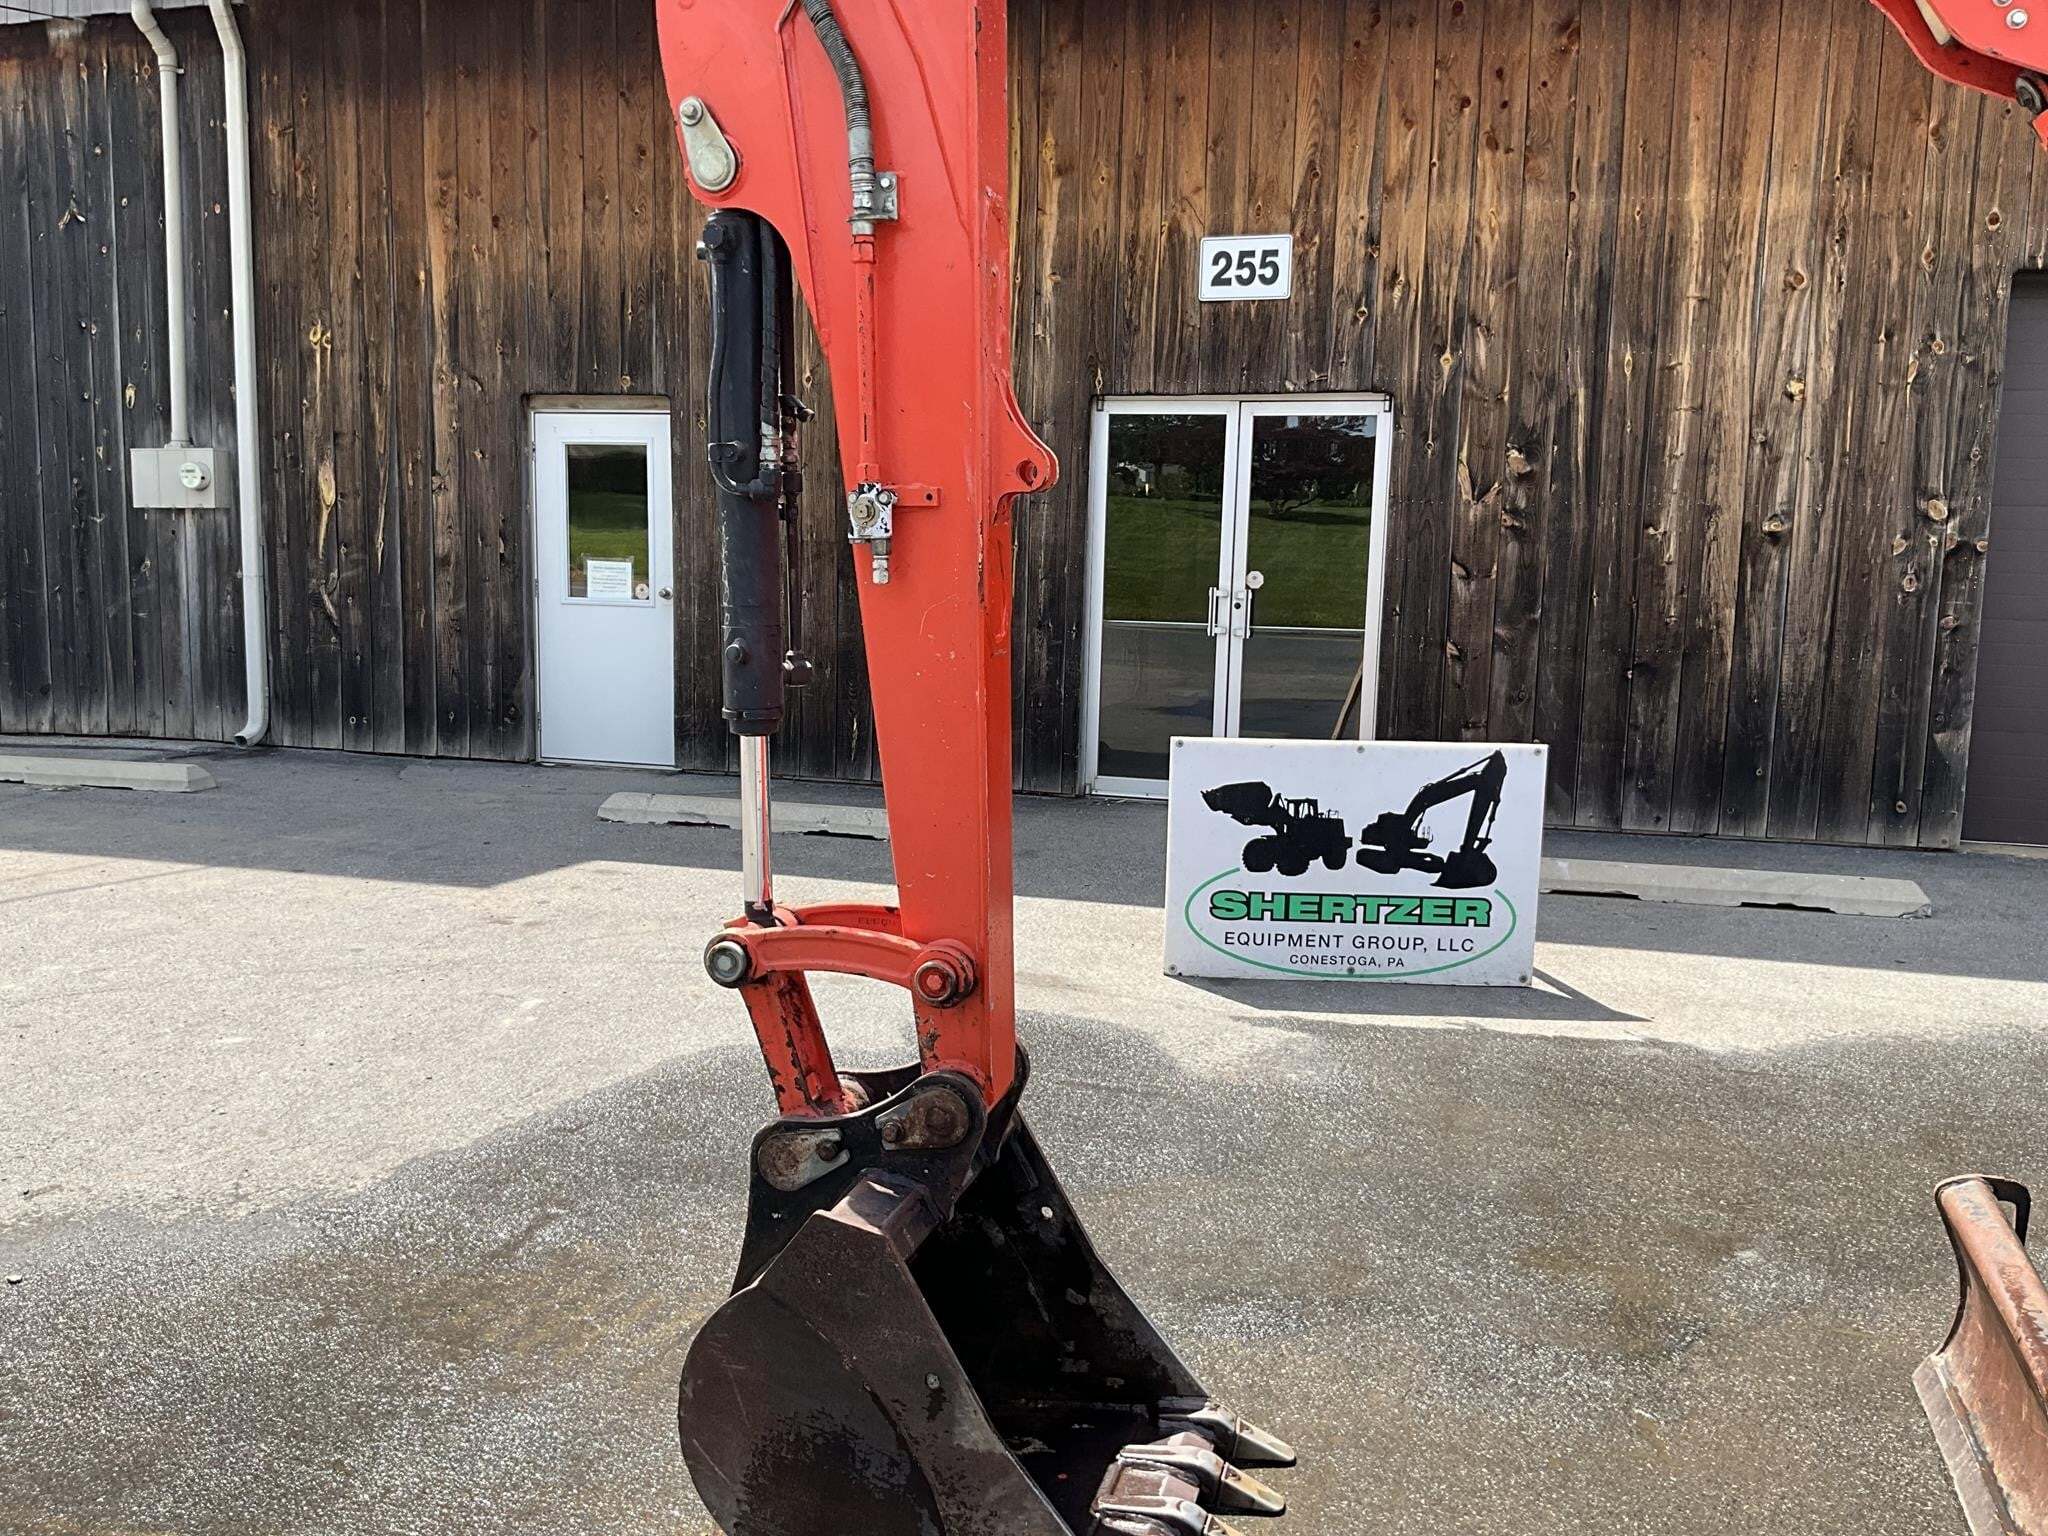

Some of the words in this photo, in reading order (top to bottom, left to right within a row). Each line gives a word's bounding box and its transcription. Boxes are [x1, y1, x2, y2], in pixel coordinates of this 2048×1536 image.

[1210, 249, 1280, 287] 255
[1209, 889, 1492, 928] SHERTZER
[1224, 931, 1344, 948] EQUIPMENT
[1352, 935, 1427, 953] GROUP,
[1437, 938, 1475, 952] LLC
[1289, 954, 1381, 968] CONESTOGA,
[1387, 957, 1405, 968] PA
